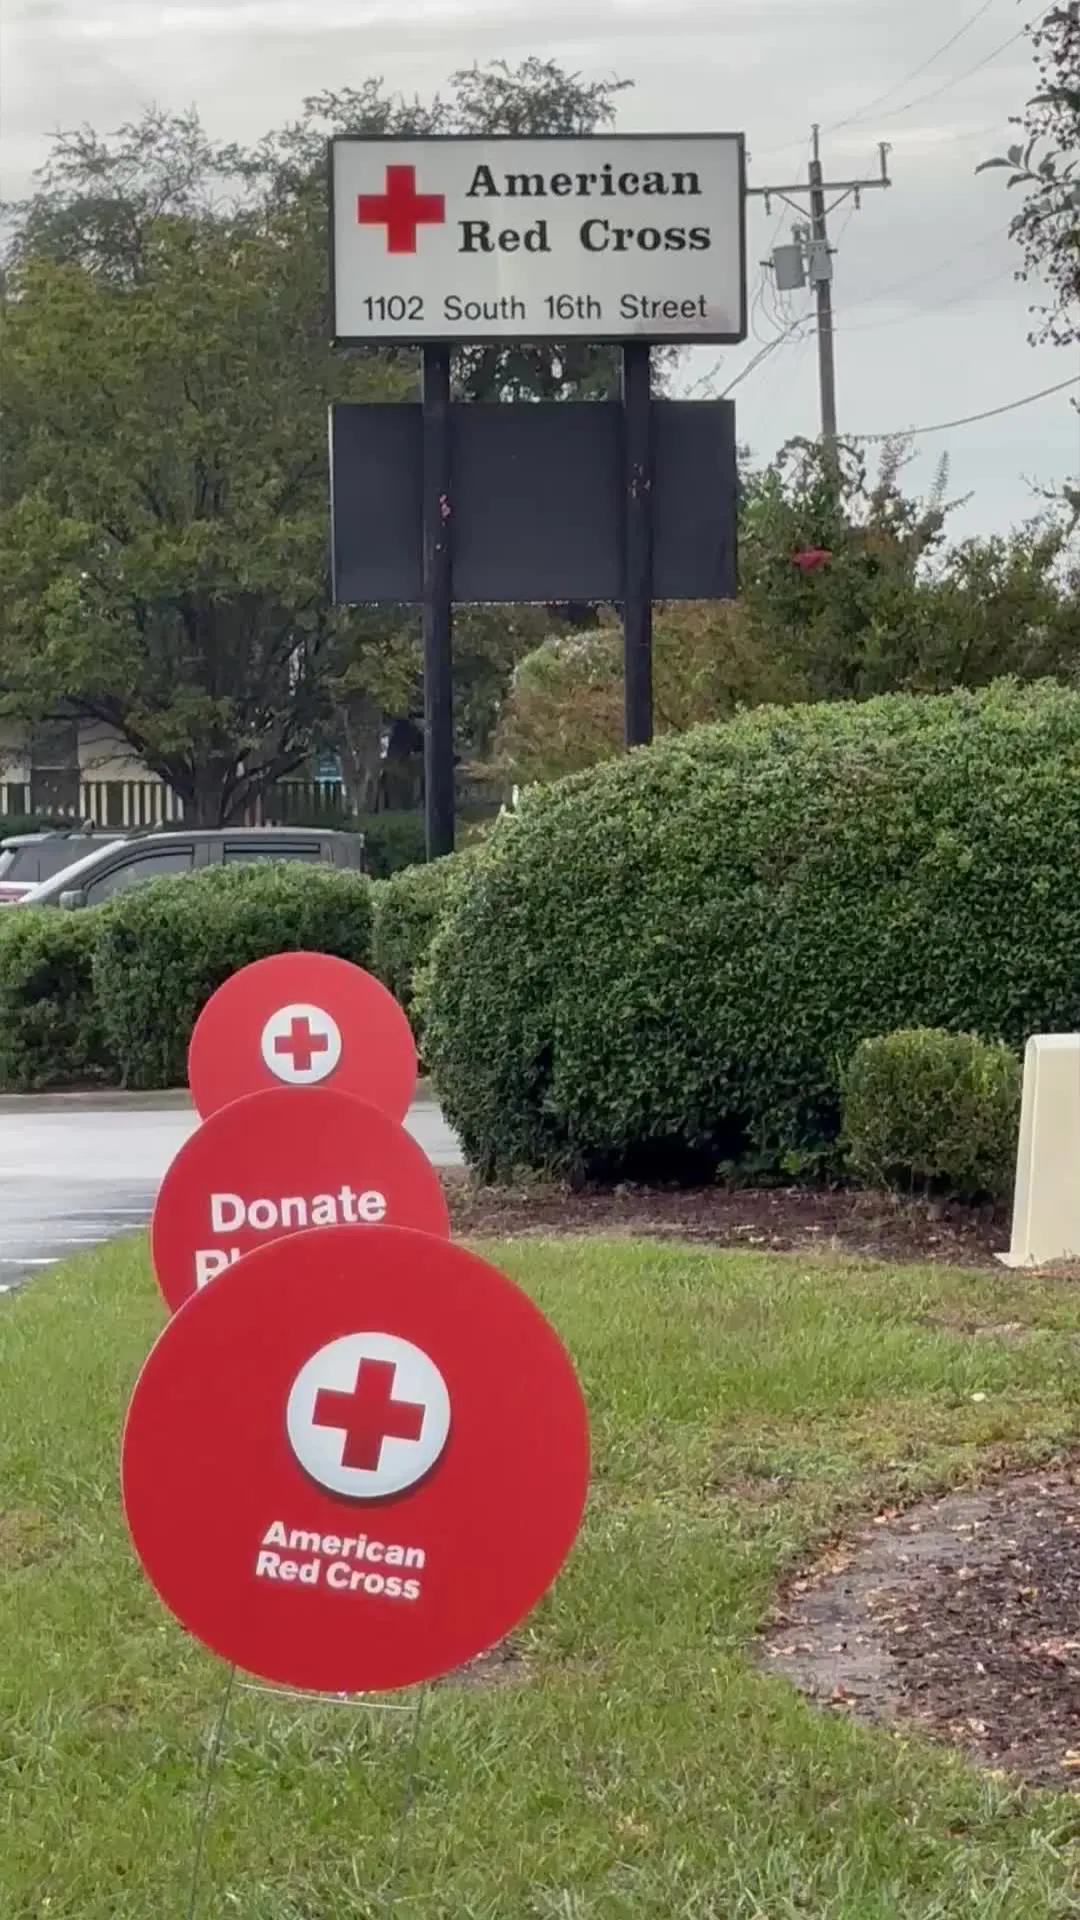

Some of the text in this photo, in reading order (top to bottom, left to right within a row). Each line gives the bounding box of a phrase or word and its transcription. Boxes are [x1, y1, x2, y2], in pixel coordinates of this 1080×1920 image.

[465, 162, 703, 198] American
[457, 218, 712, 253] Red Cross
[363, 293, 708, 321] 1102 South 16th Street
[210, 1185, 387, 1233] Donate
[261, 1520, 426, 1569] American
[255, 1549, 421, 1601] Red Cross
